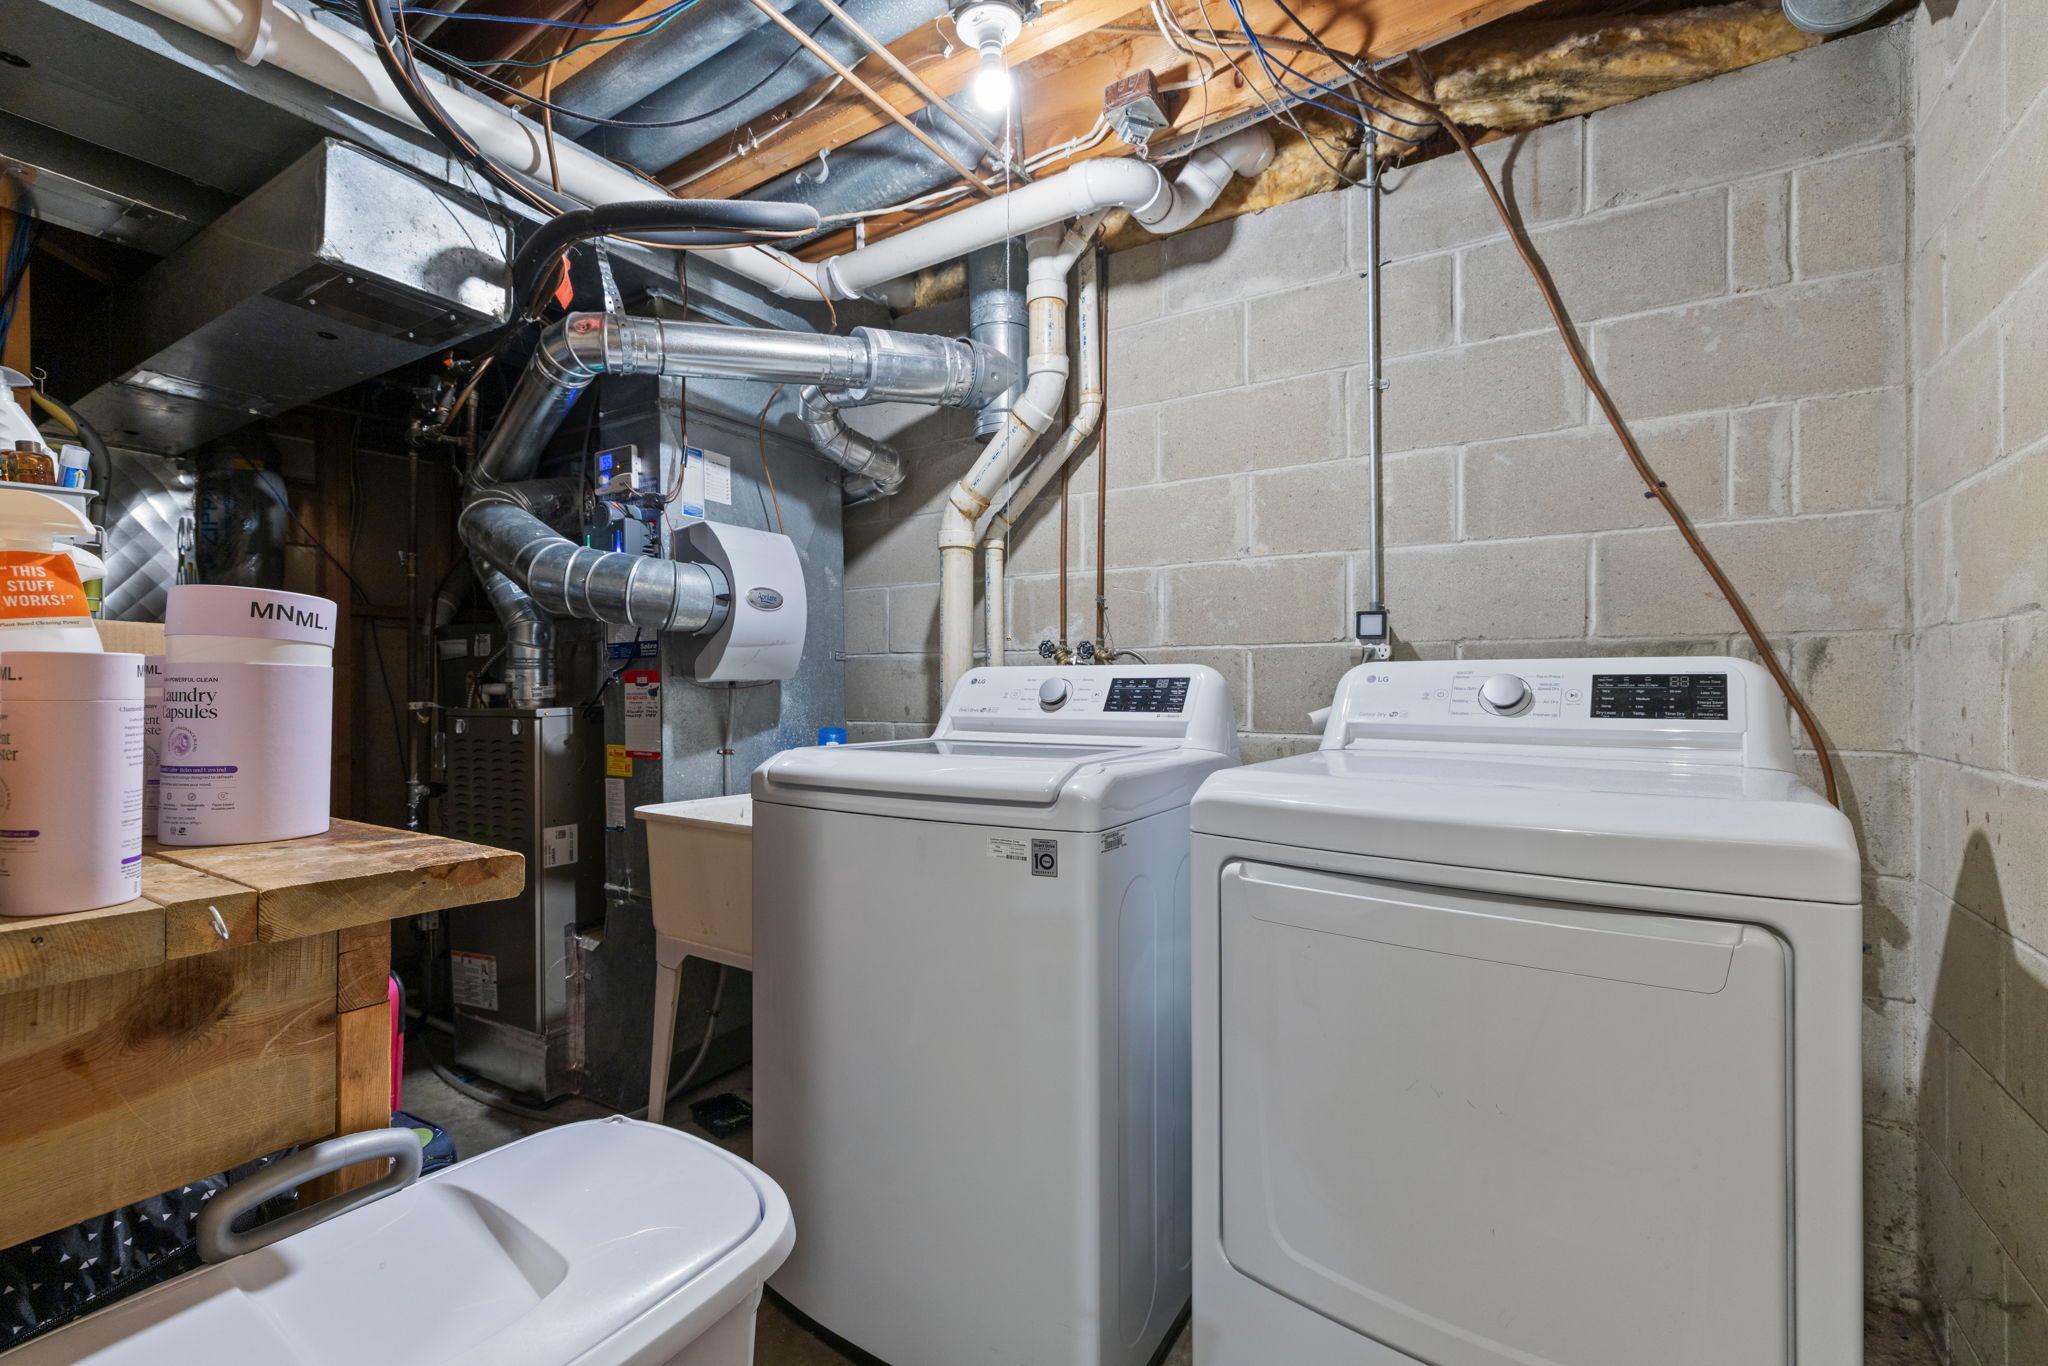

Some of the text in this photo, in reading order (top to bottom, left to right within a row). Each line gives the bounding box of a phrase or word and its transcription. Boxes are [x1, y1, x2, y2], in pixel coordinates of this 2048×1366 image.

[6, 580, 56, 592] STUFF
[250, 601, 328, 631] MNML.
[1377, 675, 1390, 683] LG
[1034, 853, 1054, 870] 10
